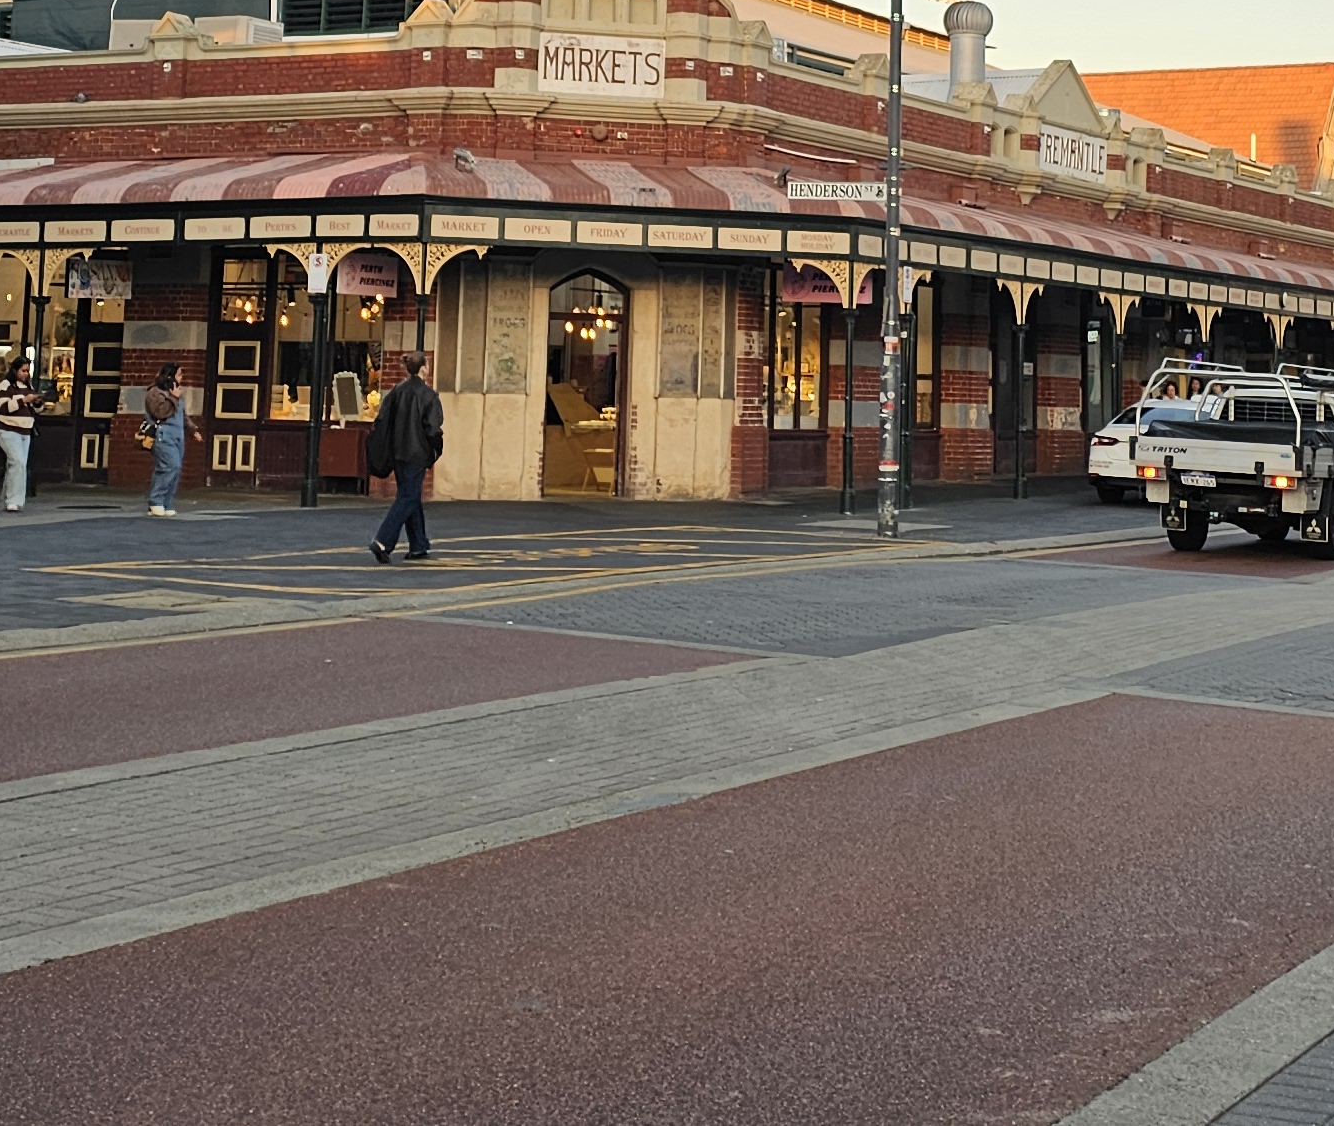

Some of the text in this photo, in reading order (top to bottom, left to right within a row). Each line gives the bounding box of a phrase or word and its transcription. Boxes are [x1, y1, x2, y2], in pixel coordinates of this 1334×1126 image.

[543, 45, 661, 86] MARKETS
[790, 184, 874, 199] HENDERSON ST
[441, 220, 834, 244] MARKET OPEN FRIDAY SATURDAY SUNDAY MONDAY
[360, 263, 384, 275] PERTH
[359, 276, 395, 288] PIERCINGZ
[1152, 446, 1187, 454] TRITON
